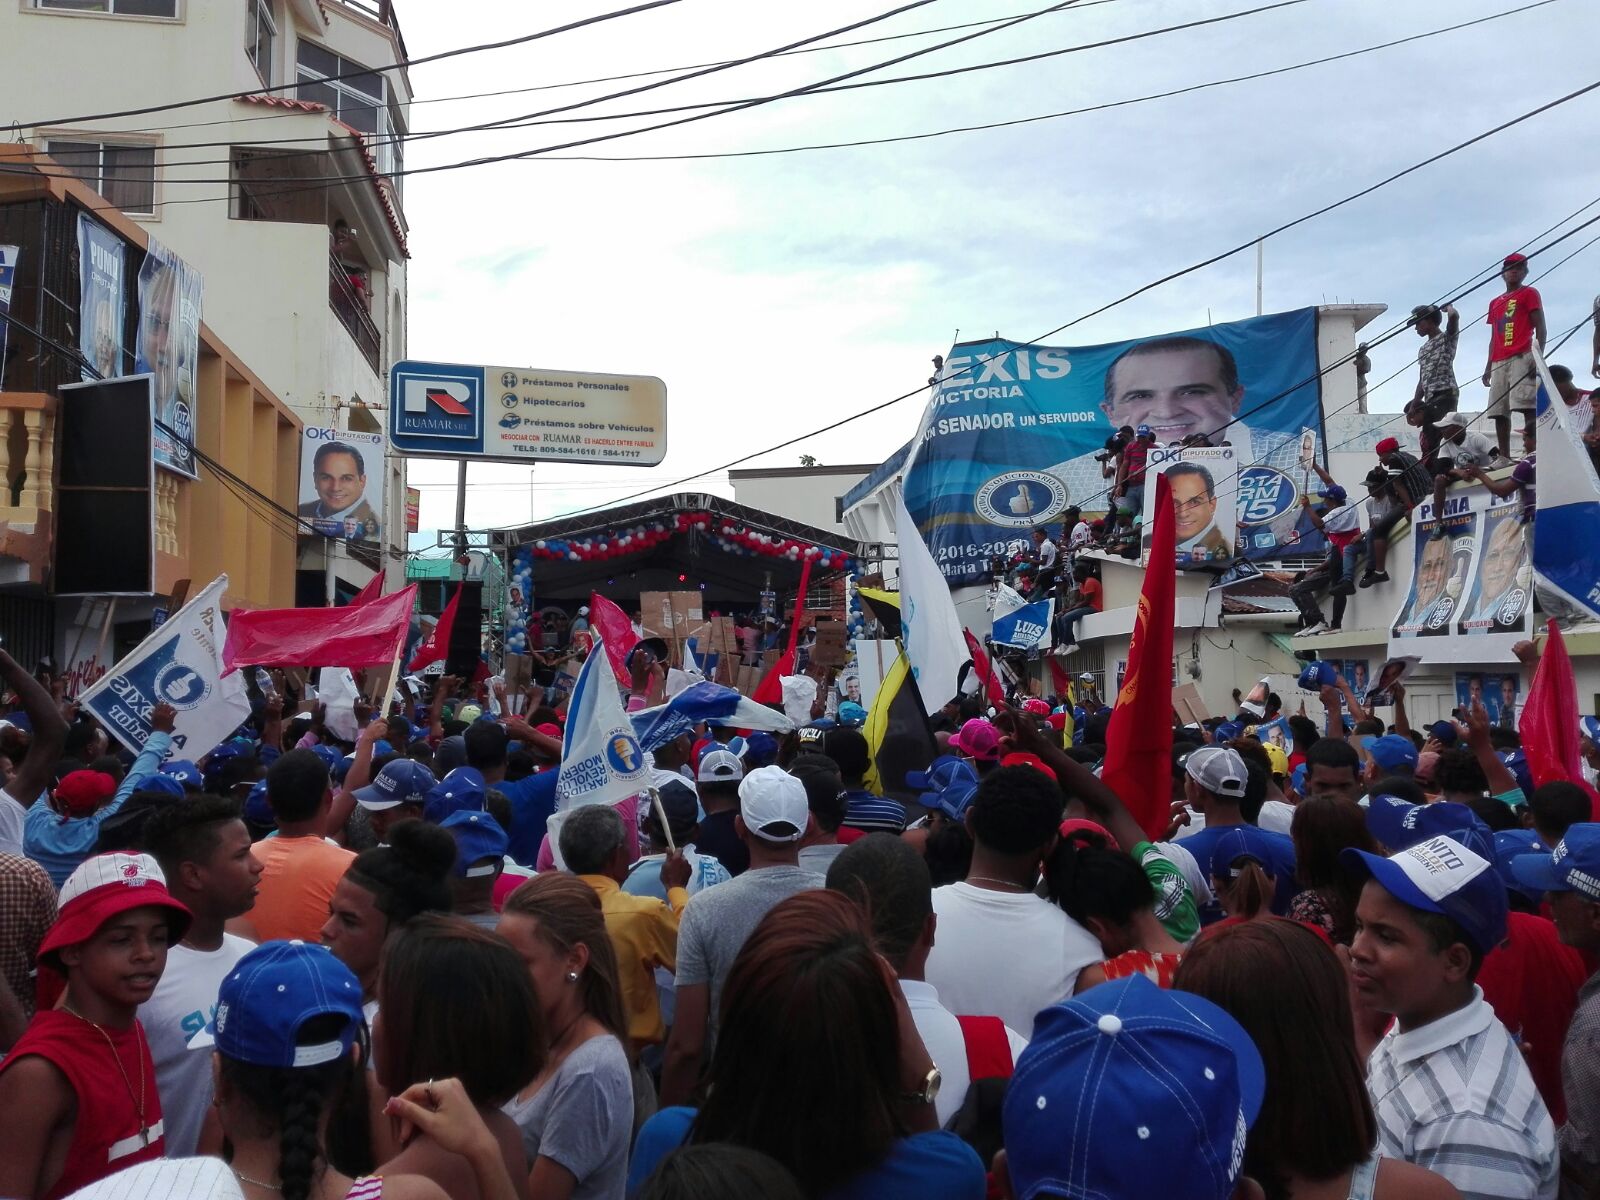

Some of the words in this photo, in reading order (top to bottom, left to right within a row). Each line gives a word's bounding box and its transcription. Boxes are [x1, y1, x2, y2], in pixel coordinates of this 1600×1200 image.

[91, 240, 118, 281] PUMA
[522, 378, 574, 388] Préstamos
[577, 381, 630, 391] Personales
[523, 397, 585, 408] Hipotecarios
[931, 385, 1024, 410] VICTORIA
[405, 418, 452, 431] RUAMAR
[524, 418, 576, 429] Préstamos
[578, 422, 605, 430] sobre
[938, 413, 1016, 435] SENADOR
[1019, 416, 1036, 427] UN
[1039, 412, 1096, 426] SERVIDOR
[336, 431, 371, 440] DIPUTADO
[501, 433, 528, 441] NEGOCIAR
[543, 433, 582, 444] RUAMAR
[513, 444, 538, 452] TELS:
[603, 449, 640, 458] 584-1717
[1237, 475, 1283, 487] OTA
[1237, 487, 1280, 500] RM
[1237, 498, 1277, 520] 15
[940, 561, 976, 577] María
[1502, 611, 1516, 624] 15
[1014, 619, 1044, 638] LUIS
[562, 773, 608, 800] PARTIDO
